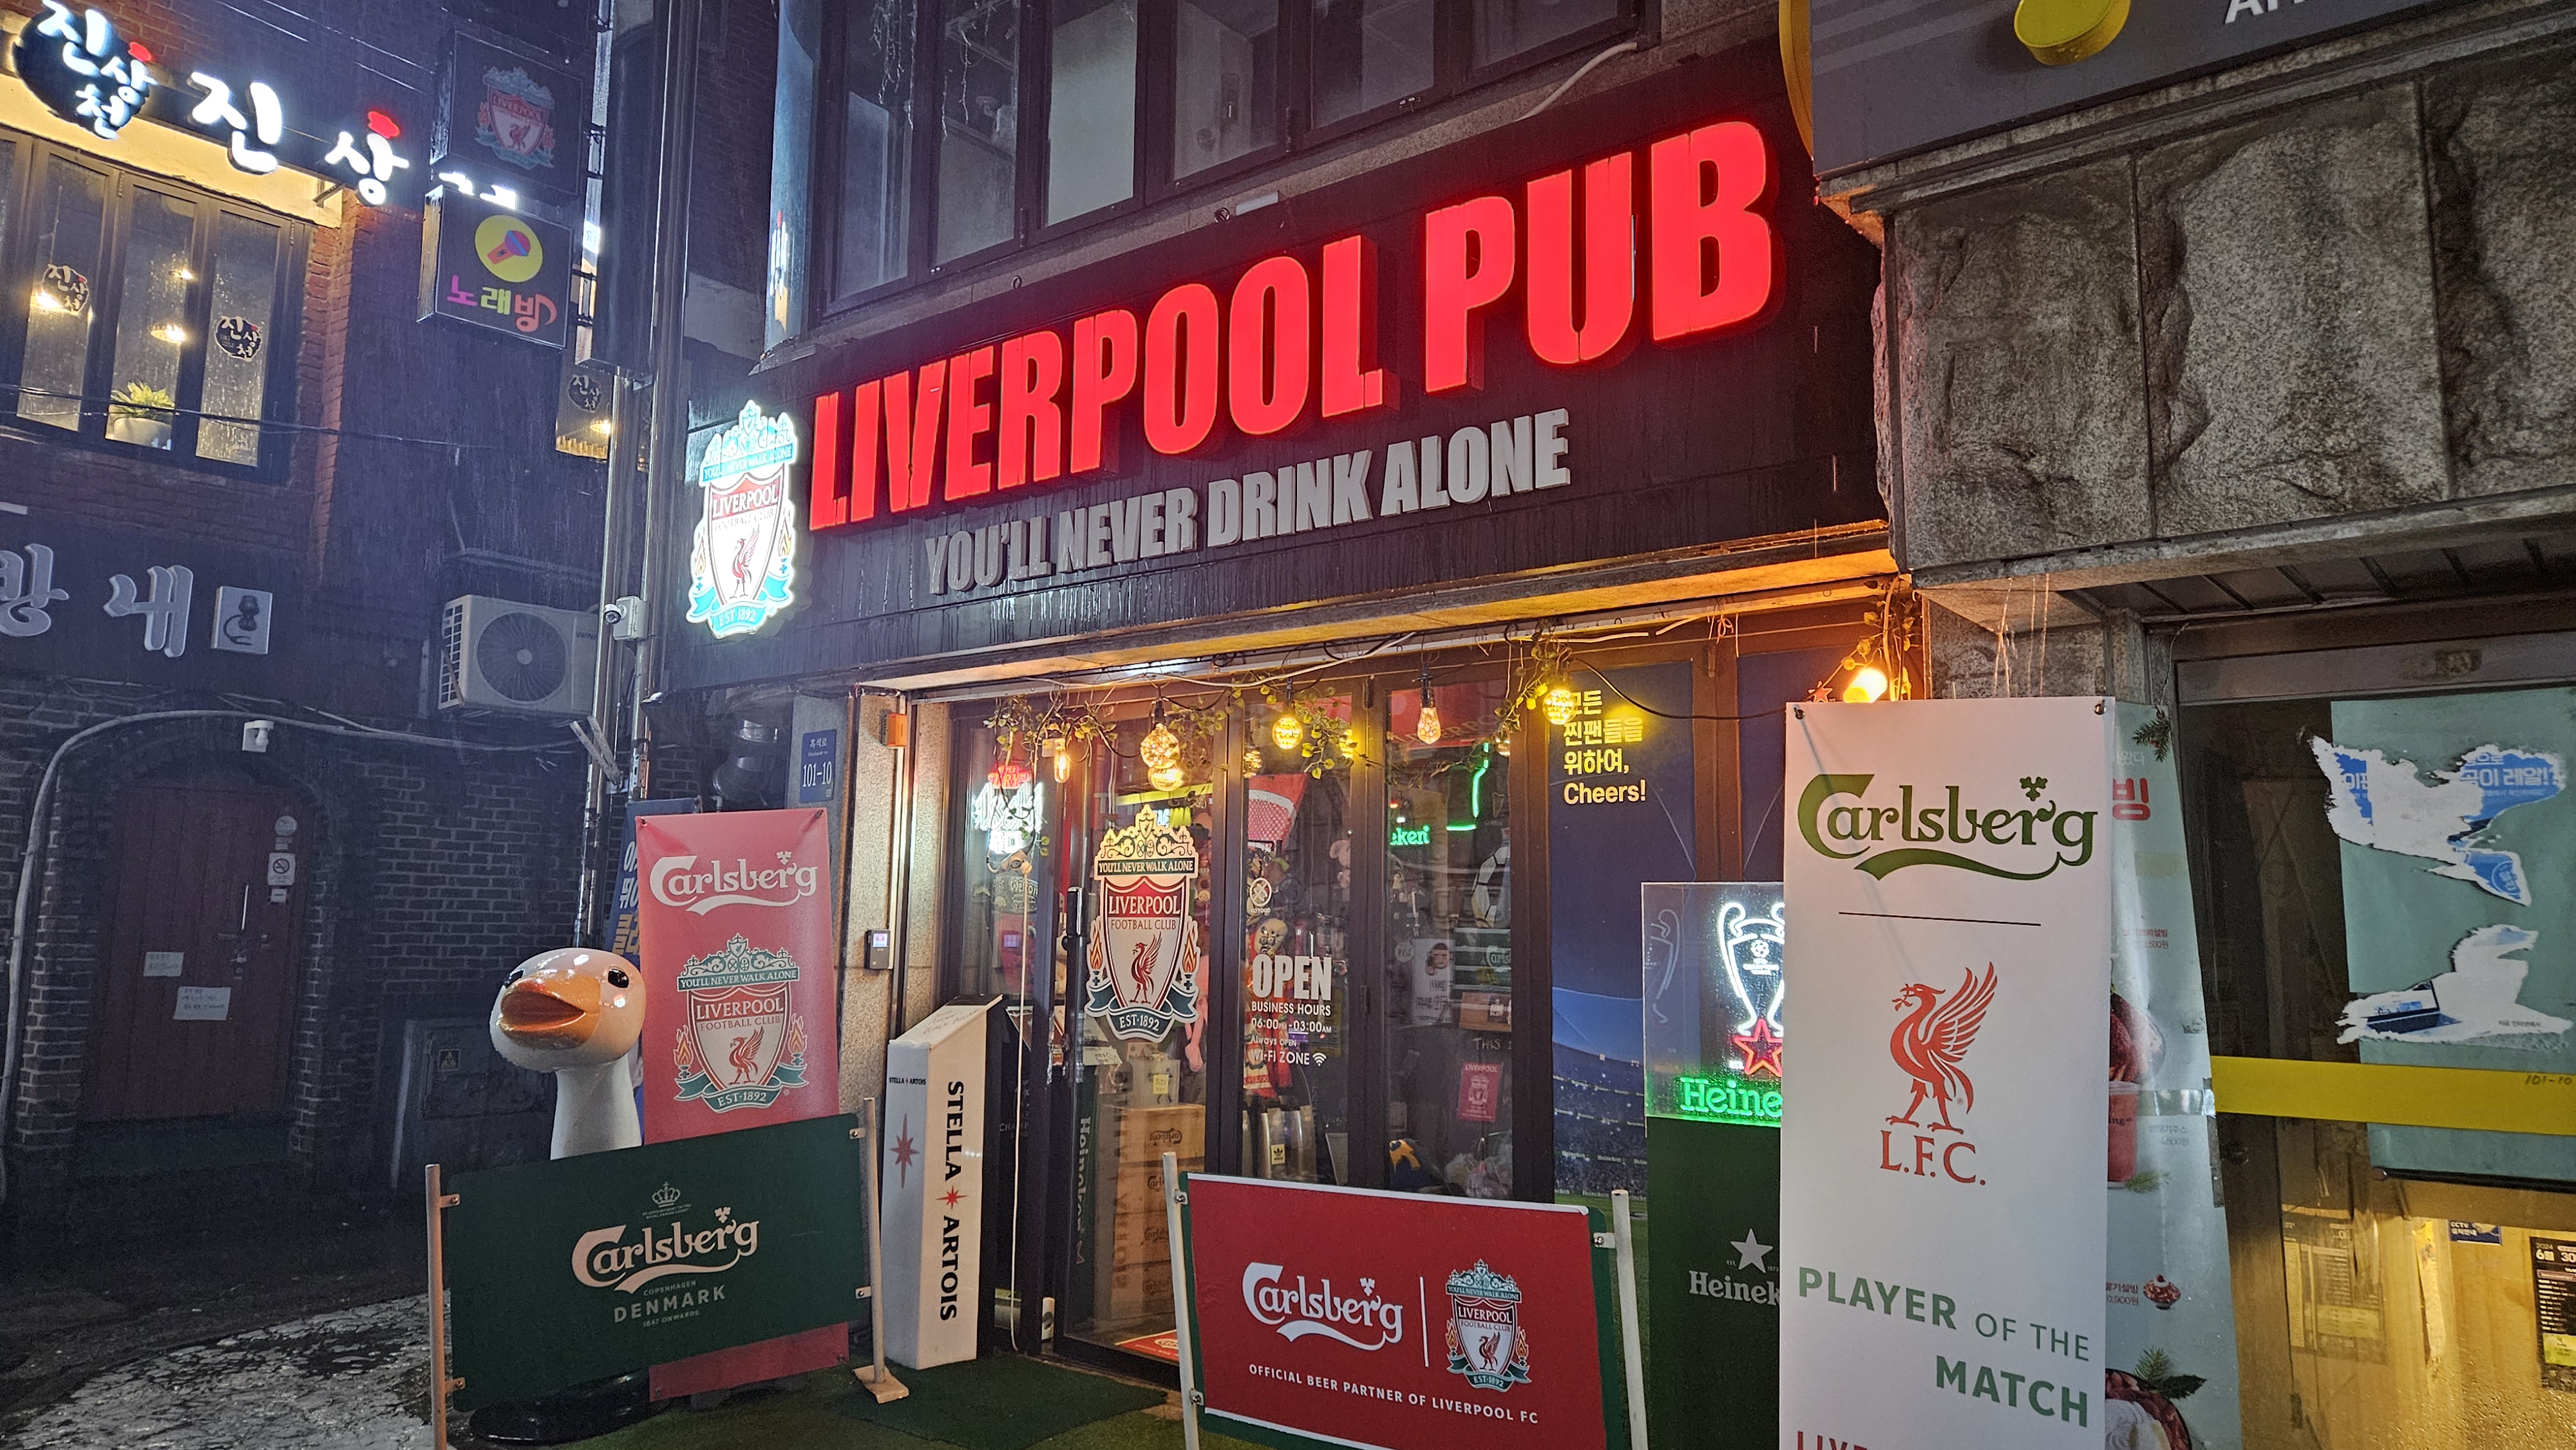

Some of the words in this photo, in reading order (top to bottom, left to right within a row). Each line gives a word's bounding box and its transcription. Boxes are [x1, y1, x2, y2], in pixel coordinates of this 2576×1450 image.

[447, 274, 558, 332] 노래방
[810, 234, 1383, 531] LIVERPOOL
[1426, 120, 1774, 393] PUB
[713, 484, 778, 517] LIVERPOOL
[925, 516, 1051, 596] YOU'LL
[1058, 487, 1197, 573] NEVER
[1208, 449, 1374, 548] DRINK
[1380, 408, 1571, 516] ALONE
[1564, 717, 1643, 746] 찐팬들을
[802, 762, 832, 787] 101-10
[1564, 748, 1629, 775] 위하여,
[1564, 779, 1647, 805] Cheers!
[1797, 775, 2098, 867] Carlsberg
[1099, 862, 1122, 873] YOU'LL
[1122, 861, 1144, 872] NEVER
[1145, 860, 1167, 871] WALK
[1168, 860, 1194, 871] ALONE
[649, 854, 818, 909] Carlsberg
[1108, 895, 1180, 915] LIVERPOOL
[1111, 919, 1152, 930] FOOTBALL
[1155, 919, 1177, 930] CLUB
[679, 976, 711, 989] YOU'LL
[711, 974, 739, 986] NEVER
[740, 972, 766, 984] WALK
[767, 969, 797, 981] ALONE
[1253, 954, 1332, 1001] OPEN
[696, 997, 784, 1020] LIVERPOOL
[1251, 1001, 1294, 1013] BUSINESS
[1298, 1004, 1332, 1017] HOURS
[700, 1018, 752, 1031] FOOTBALL
[754, 1015, 781, 1026] CLUB
[1251, 1035, 1277, 1046] Always
[1279, 1039, 1297, 1048] OPEN
[1280, 1051, 1310, 1066] ZONE
[1464, 1064, 1498, 1073] LIVERPOOL
[945, 1081, 965, 1182] STELLA
[1880, 1129, 1986, 1186] L.F.C.
[572, 1219, 760, 1288] Carlsberg
[940, 1216, 960, 1321] ARTOIS
[644, 1279, 697, 1297] COPENHAGEN
[1465, 1288, 1483, 1297] NEVER
[1483, 1290, 1501, 1299] WALK
[1500, 1292, 1520, 1301] ALONE
[1689, 1270, 1780, 1306] Heinek
[614, 1285, 726, 1324] DENMARK
[661, 1309, 699, 1325] ONWARDS
[1242, 1262, 1403, 1344] Carlsberg
[1458, 1306, 1512, 1323] LIVERPOOL
[1799, 1266, 1957, 1330] PLAYER
[1975, 1313, 2017, 1342] OF
[2029, 1323, 2090, 1362] THE
[1461, 1321, 1492, 1330] FOOTBALL
[1249, 1363, 1302, 1384] OFFICIAL
[1306, 1375, 1338, 1391] BEER
[1343, 1381, 1403, 1403] PARTNER
[1408, 1393, 1426, 1407] OF
[1432, 1397, 1514, 1422] LIVERPOOL
[1520, 1410, 1539, 1424] FC
[1936, 1355, 2088, 1428] MATCH
